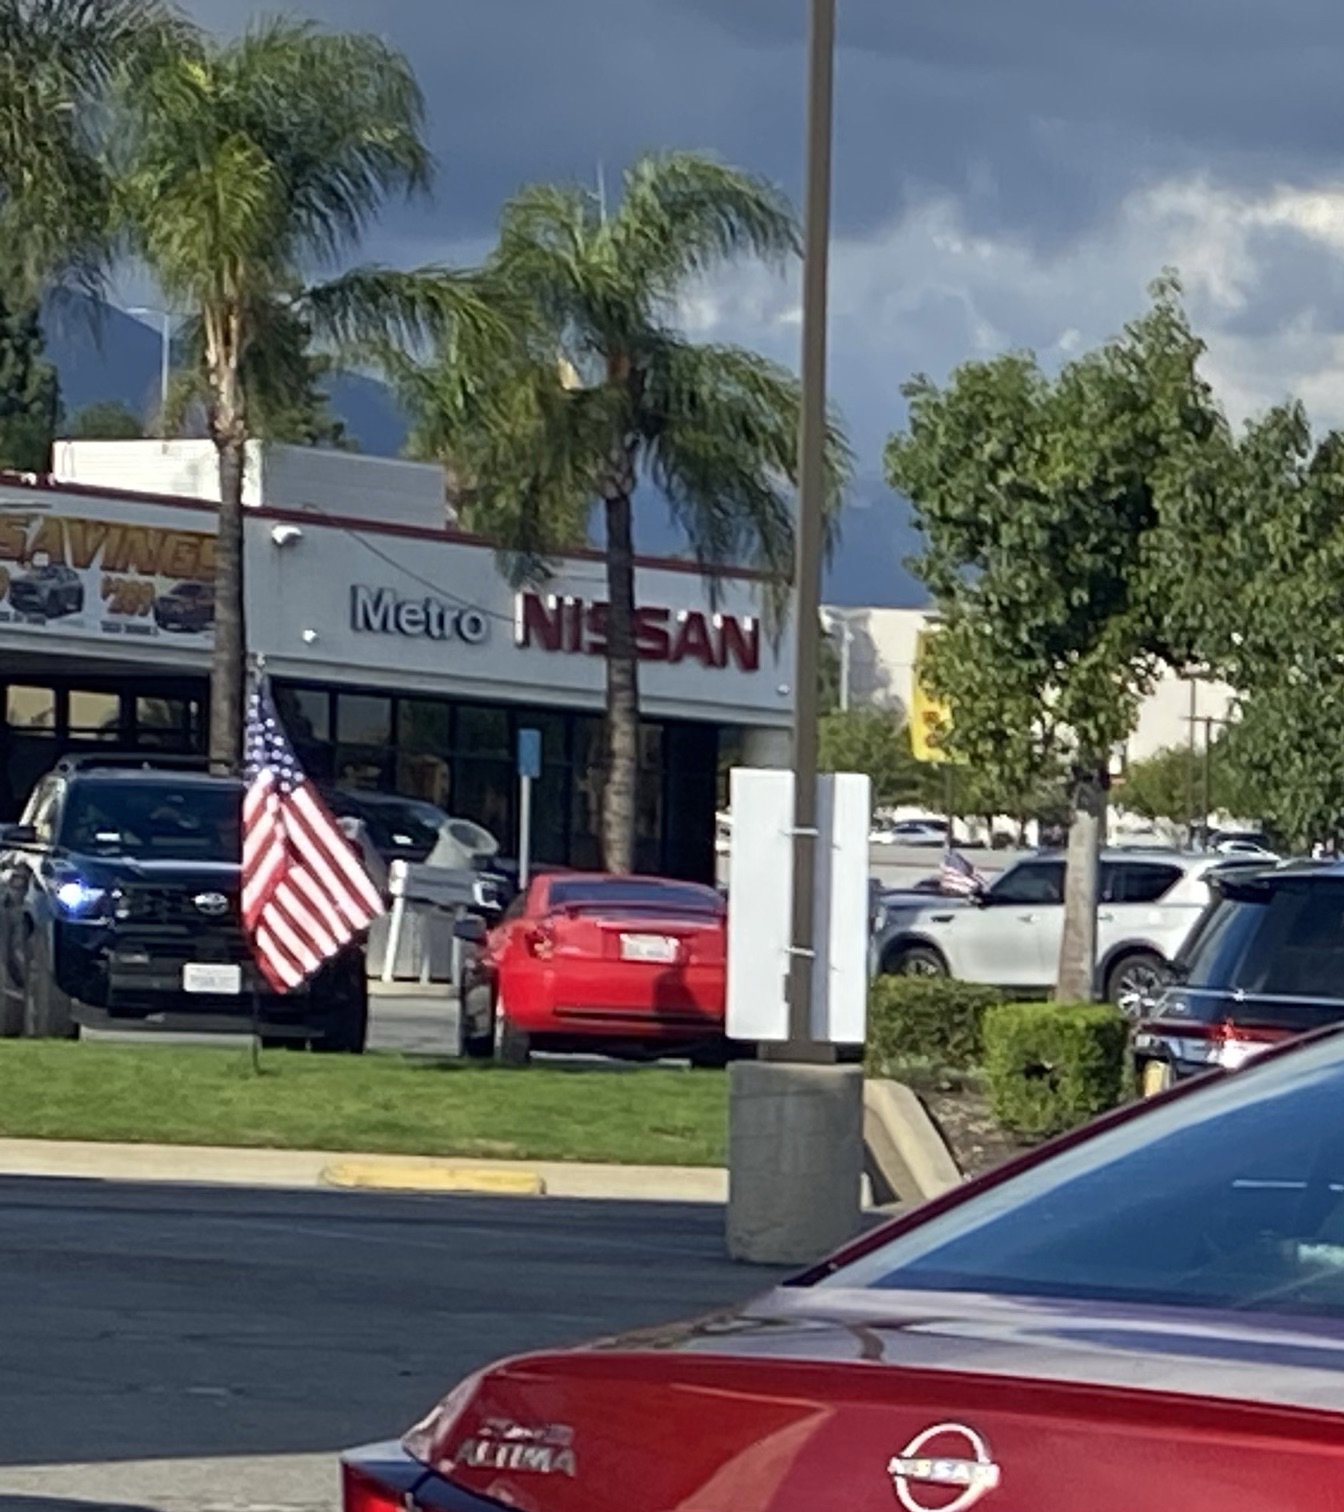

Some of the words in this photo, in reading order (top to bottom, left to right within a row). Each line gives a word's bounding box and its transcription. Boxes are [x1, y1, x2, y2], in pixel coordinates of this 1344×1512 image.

[350, 585, 488, 644] Metro
[514, 592, 760, 671] NISSAN
[455, 1439, 577, 1478] ALTIMA
